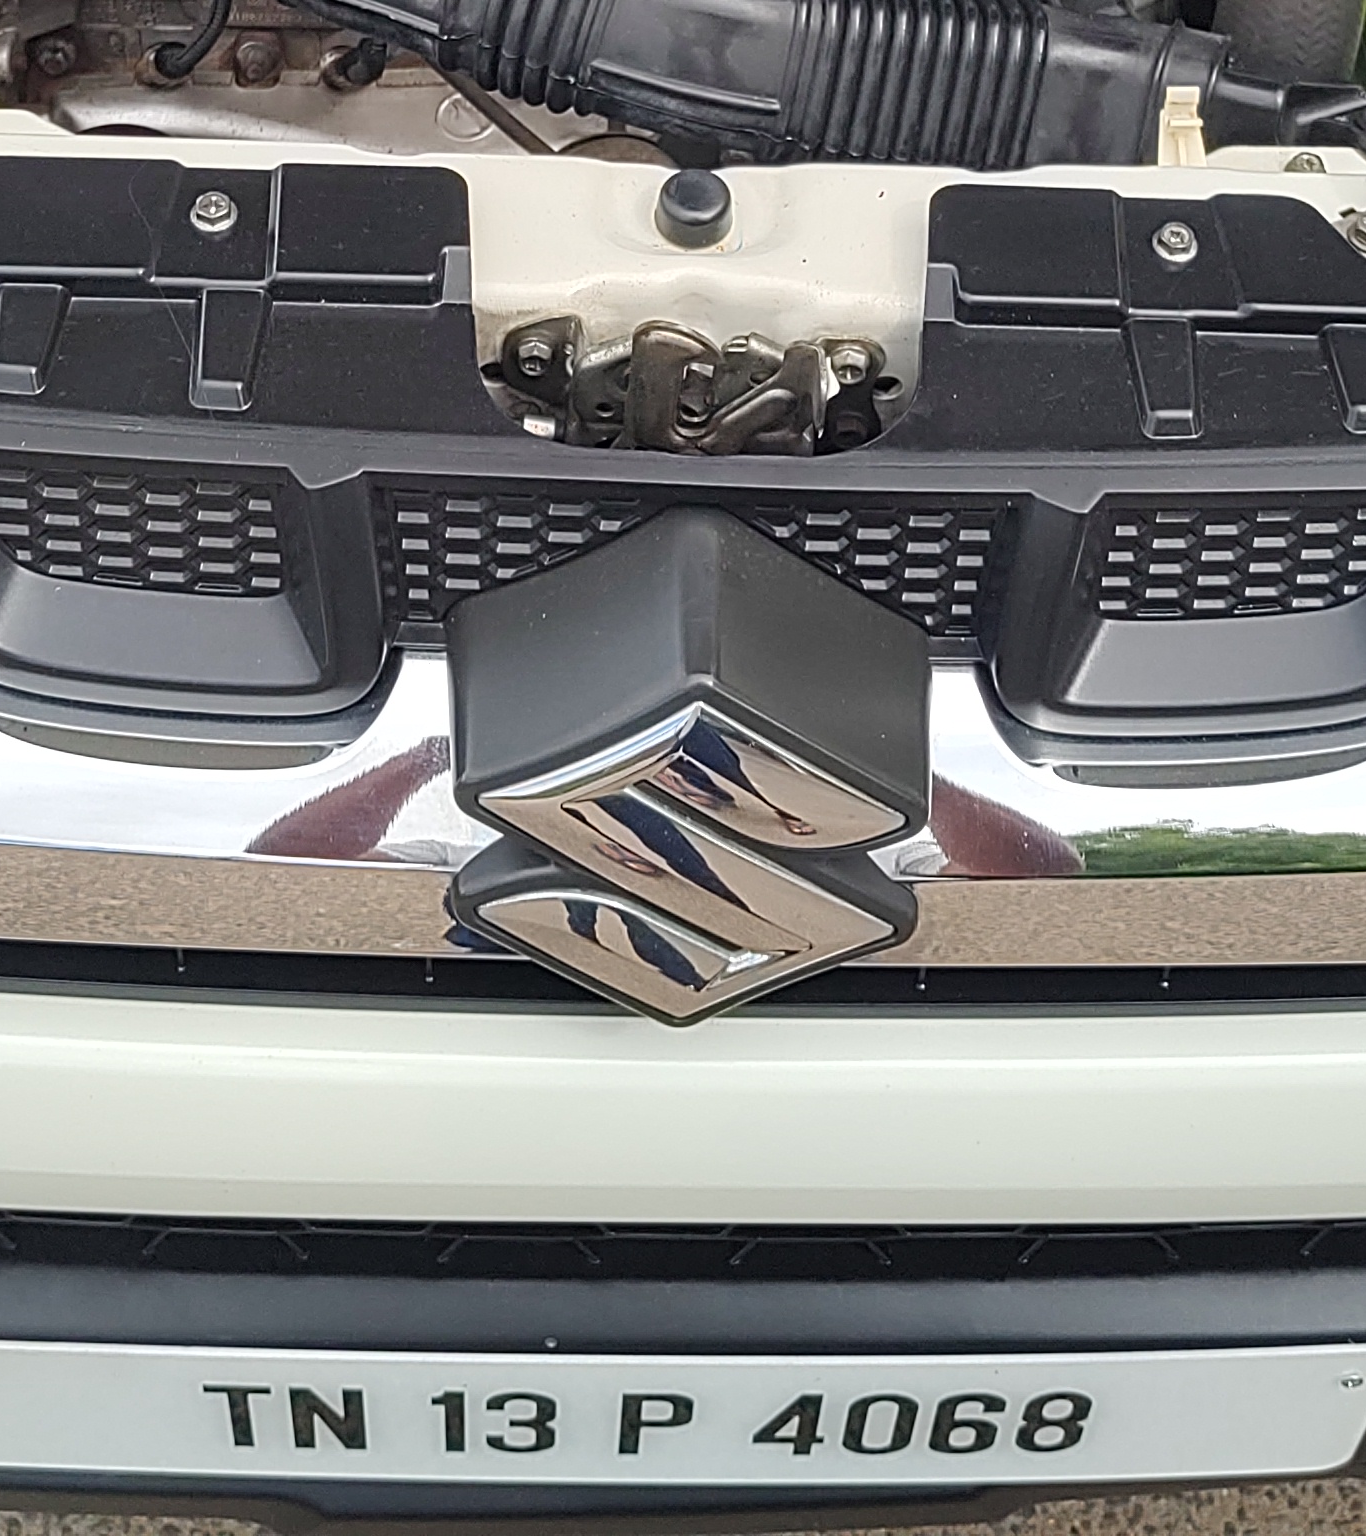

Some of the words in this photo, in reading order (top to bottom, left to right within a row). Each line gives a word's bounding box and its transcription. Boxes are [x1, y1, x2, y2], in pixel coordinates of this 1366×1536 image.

[202, 1383, 368, 1450] TN
[430, 1390, 558, 1452] 13
[618, 1393, 695, 1454] P
[752, 1391, 1093, 1455] 4068
